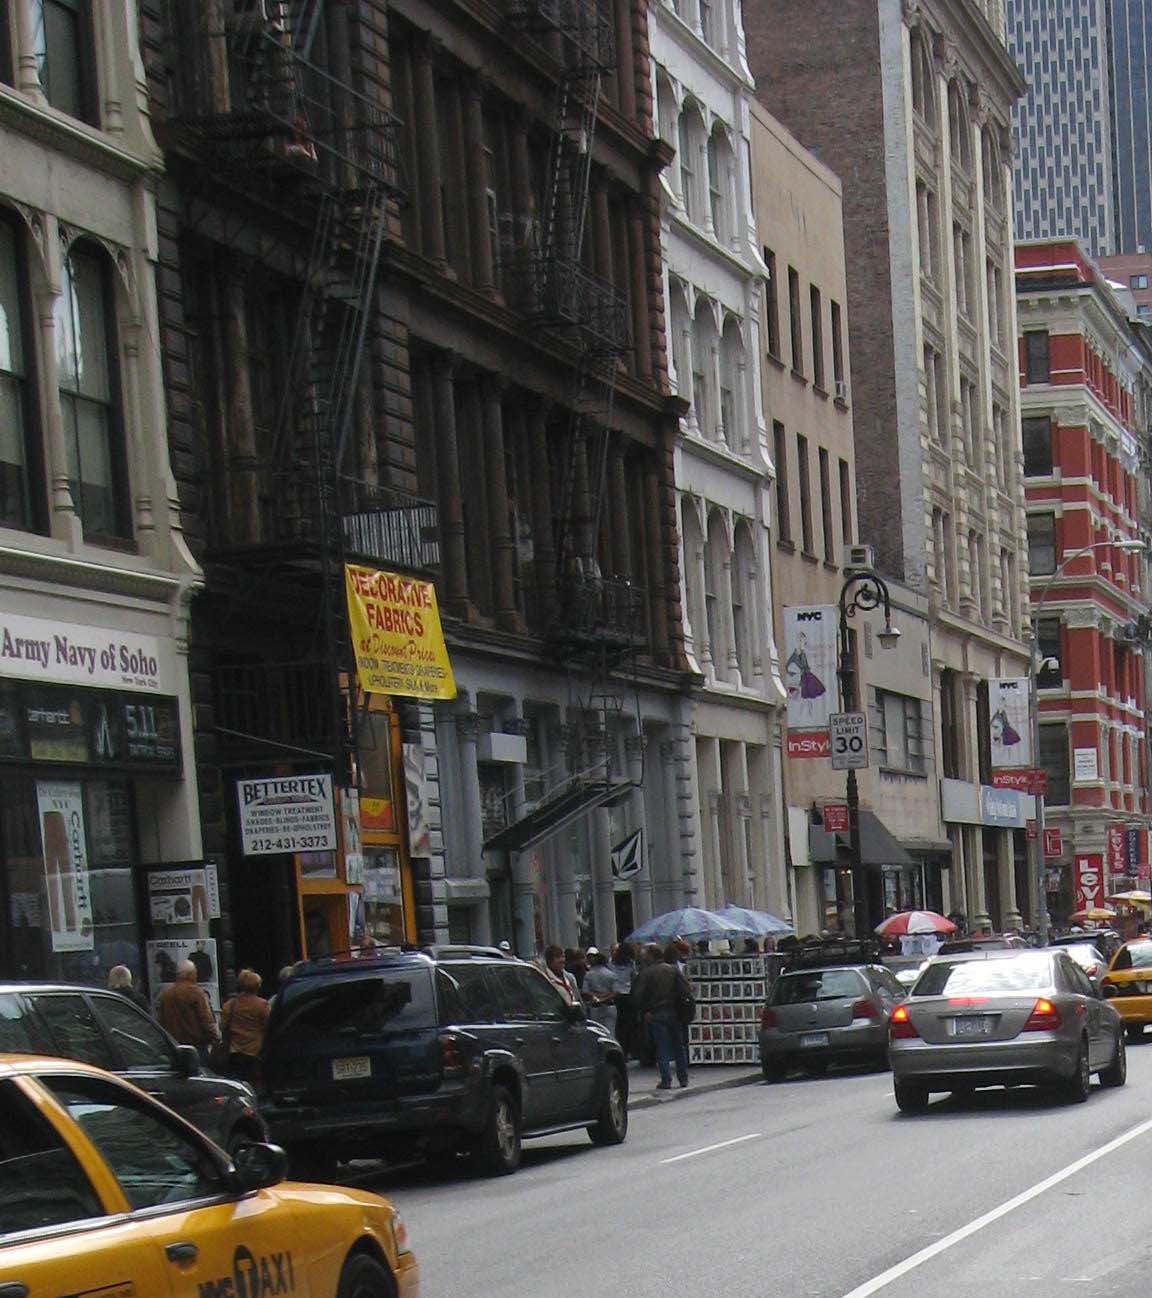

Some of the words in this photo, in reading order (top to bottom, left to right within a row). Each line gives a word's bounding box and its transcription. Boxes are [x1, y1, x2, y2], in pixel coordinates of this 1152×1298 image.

[366, 604, 424, 637] FABRICS
[797, 611, 823, 621] NYC
[2, 627, 50, 668] Army
[54, 634, 96, 674] Navy
[101, 644, 116, 671] of
[120, 645, 157, 676] Soho
[833, 716, 863, 726] SPEED
[836, 726, 860, 735] LIMIT
[836, 736, 863, 754] 30
[243, 777, 327, 806] BETTERTEX
[252, 836, 328, 851] 212-431-3373
